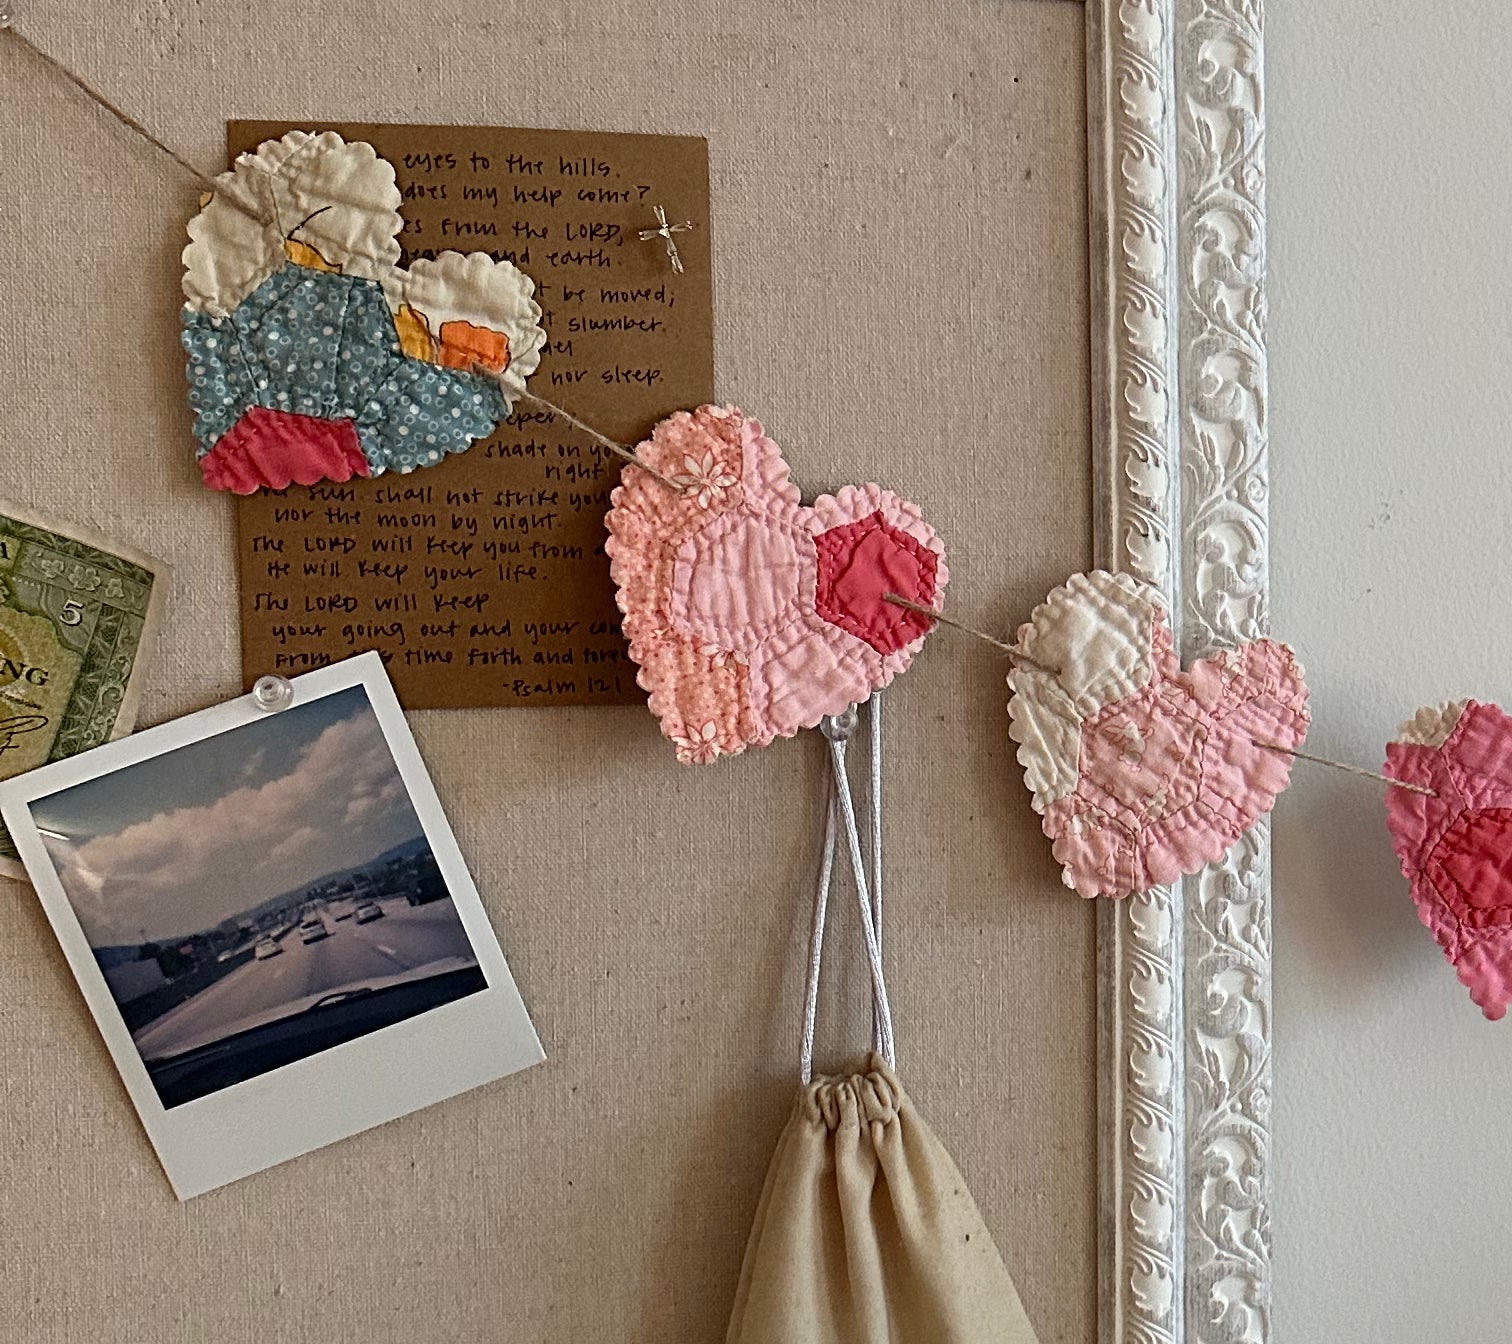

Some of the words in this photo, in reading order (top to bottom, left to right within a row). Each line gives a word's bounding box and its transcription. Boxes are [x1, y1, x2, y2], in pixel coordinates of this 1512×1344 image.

[403, 153, 456, 172] eyes
[470, 152, 490, 172] to
[506, 154, 543, 175] the
[560, 156, 621, 178] hills.
[404, 182, 447, 200] does
[463, 186, 497, 208] my
[513, 186, 561, 207] help
[511, 221, 548, 239] the
[546, 249, 622, 267] earth.
[563, 285, 585, 302] be
[600, 285, 674, 307] moved;
[568, 316, 667, 332] slumber.
[552, 371, 587, 386] nor
[602, 365, 664, 386] sleep.
[486, 439, 546, 458] shade
[558, 444, 580, 457] on
[546, 462, 604, 483] right
[309, 487, 355, 501] sun
[375, 486, 432, 504] shall
[447, 488, 484, 506] not
[494, 488, 559, 506] strike
[275, 508, 314, 523] nor
[324, 507, 361, 524] the
[377, 513, 436, 527] moon
[452, 515, 477, 536] by
[493, 513, 562, 534] night.
[253, 536, 284, 552] The
[304, 537, 356, 554] LORD
[372, 534, 412, 553] will
[484, 541, 520, 560] you
[267, 560, 290, 578] He
[303, 559, 340, 577] will
[424, 566, 482, 590] your
[499, 563, 547, 583] life.
[255, 591, 288, 611] The
[304, 594, 357, 612] LORD
[374, 593, 417, 612] will
[59, 599, 84, 627] 5
[272, 623, 326, 645] your
[342, 620, 405, 645] going
[420, 620, 461, 637] out
[470, 619, 511, 637] and
[524, 621, 580, 645] your
[405, 648, 453, 665] time
[468, 648, 521, 666] forth
[533, 648, 573, 665] and
[588, 676, 621, 695] 121
